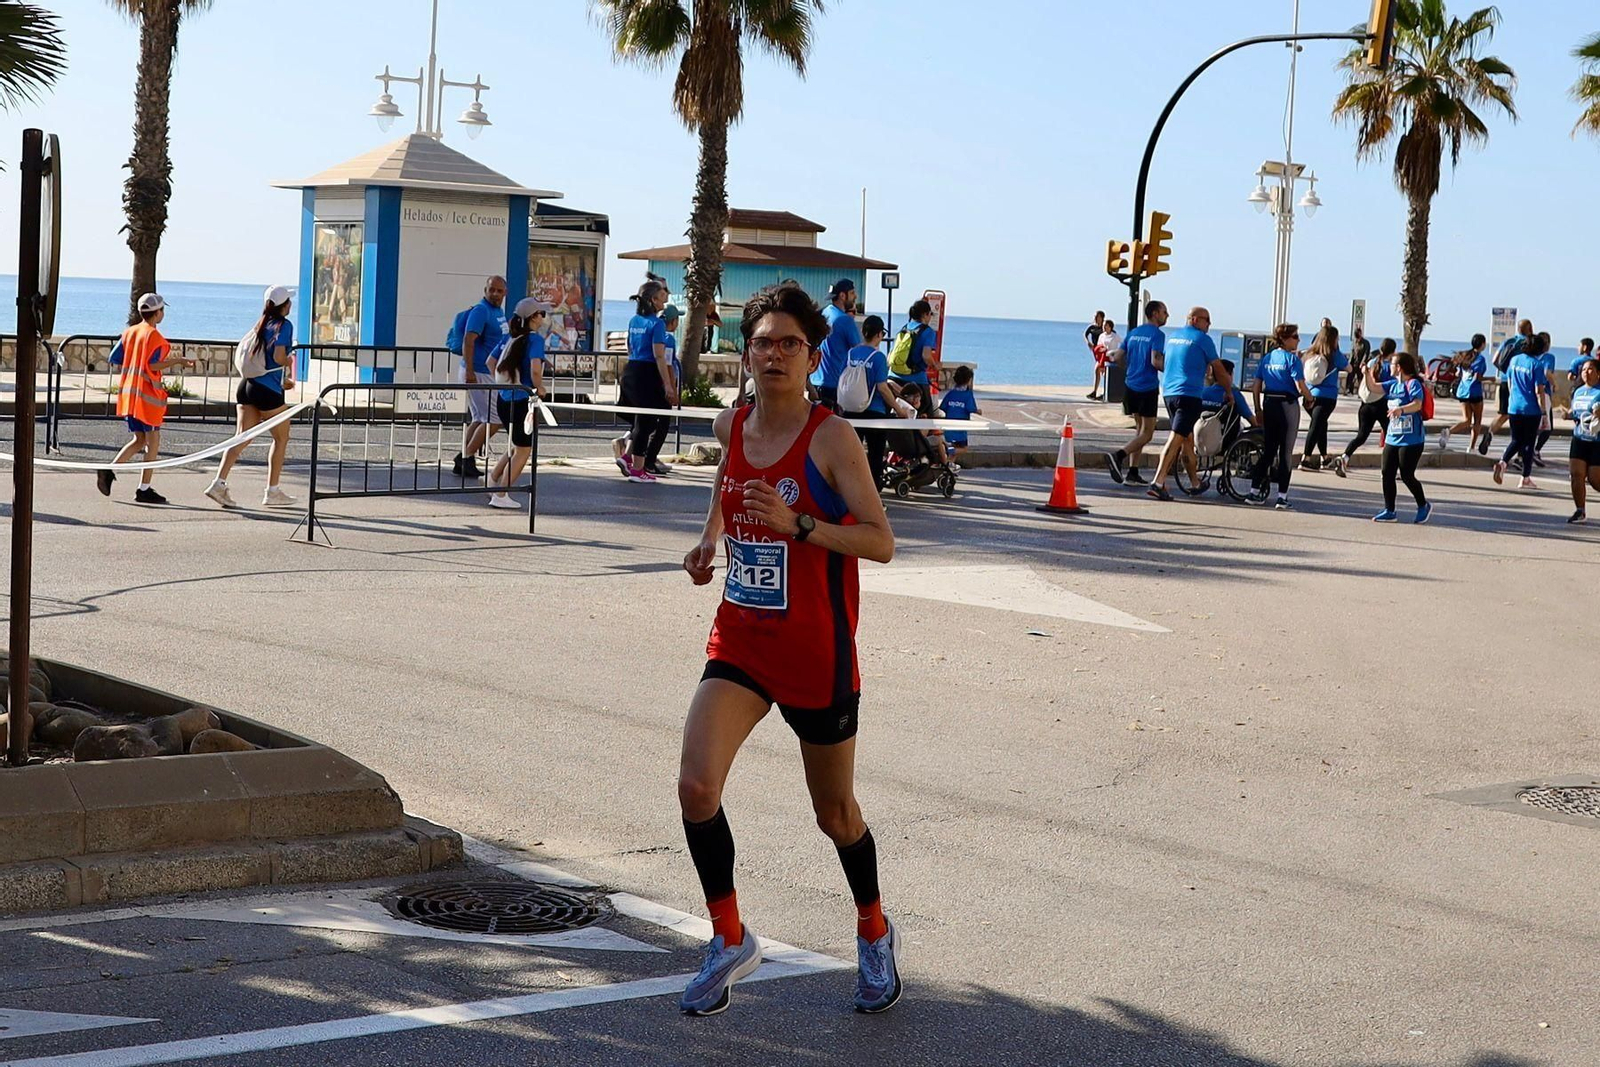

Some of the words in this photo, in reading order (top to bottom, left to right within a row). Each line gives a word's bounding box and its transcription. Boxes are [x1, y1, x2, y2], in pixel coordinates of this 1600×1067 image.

[403, 208, 443, 222] Helados
[452, 211, 467, 224] Ice
[469, 212, 506, 226] Creams
[406, 391, 433, 401] POLA
[435, 391, 458, 401] LOCAL
[754, 547, 781, 555] mayoral
